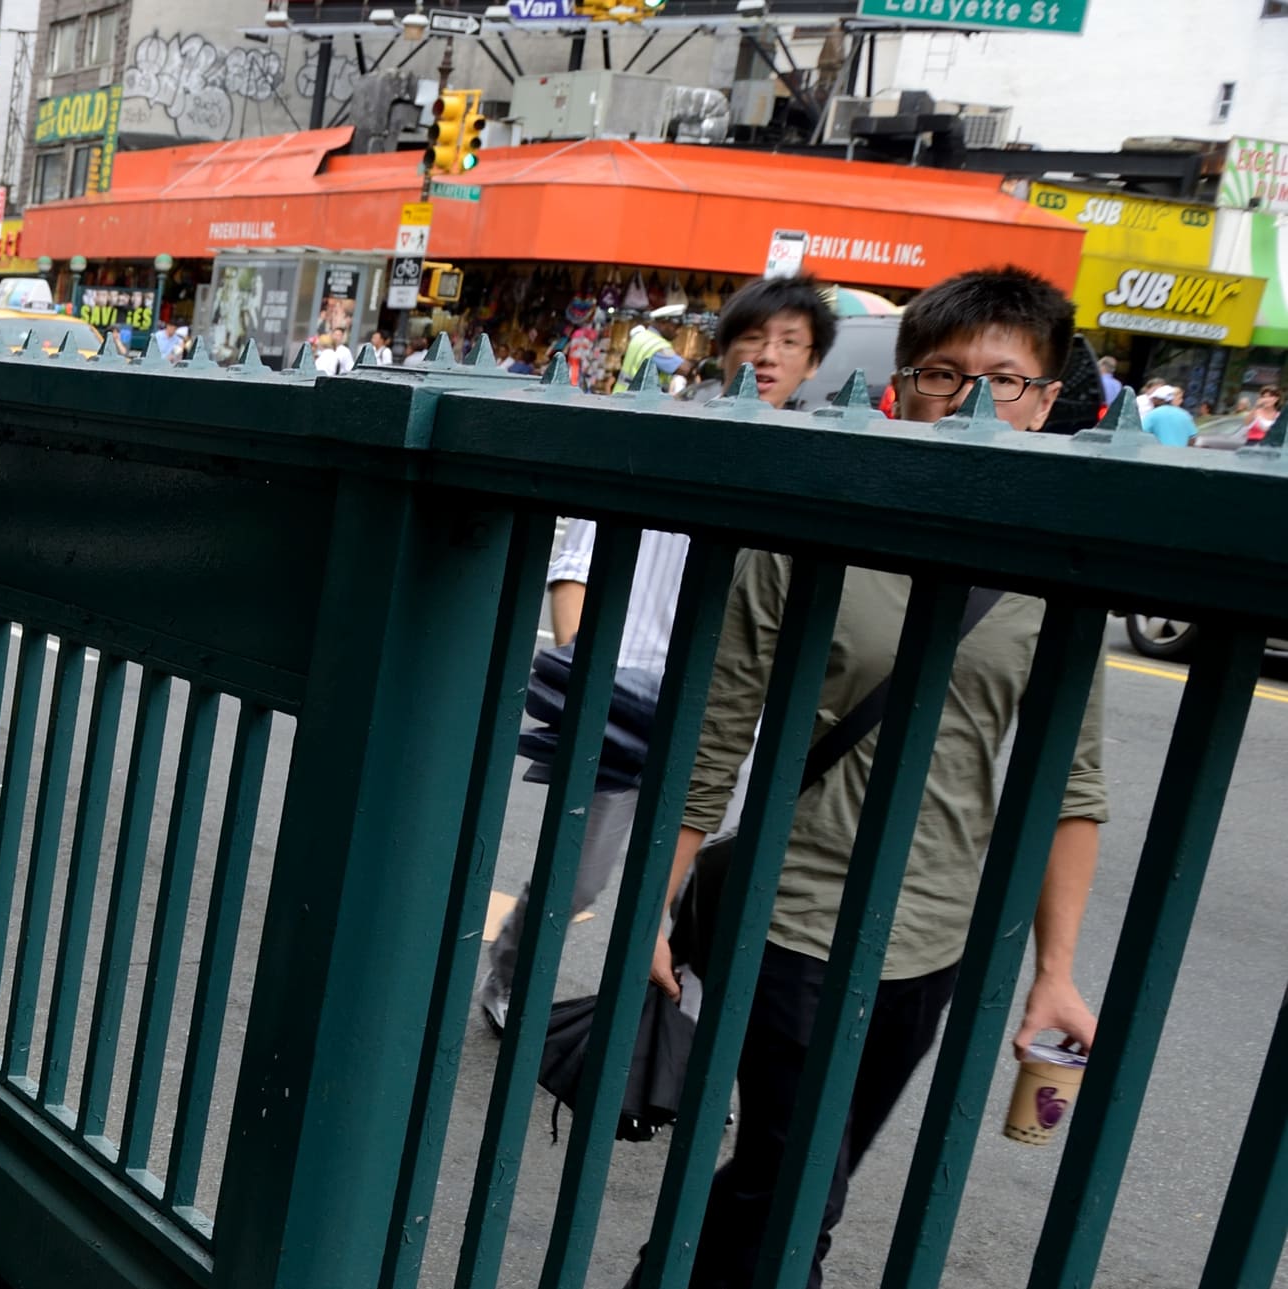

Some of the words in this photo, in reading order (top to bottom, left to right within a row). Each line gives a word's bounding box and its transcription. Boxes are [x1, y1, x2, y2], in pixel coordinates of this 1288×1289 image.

[518, 0, 557, 17] Van
[1028, 2, 1060, 25] St
[56, 91, 108, 138] GOLD
[1077, 197, 1171, 231] SUBWAY
[209, 221, 241, 239] PHOENIX
[849, 238, 892, 264] MALL
[893, 243, 927, 267] INC.
[1104, 269, 1243, 317] SUBWAY
